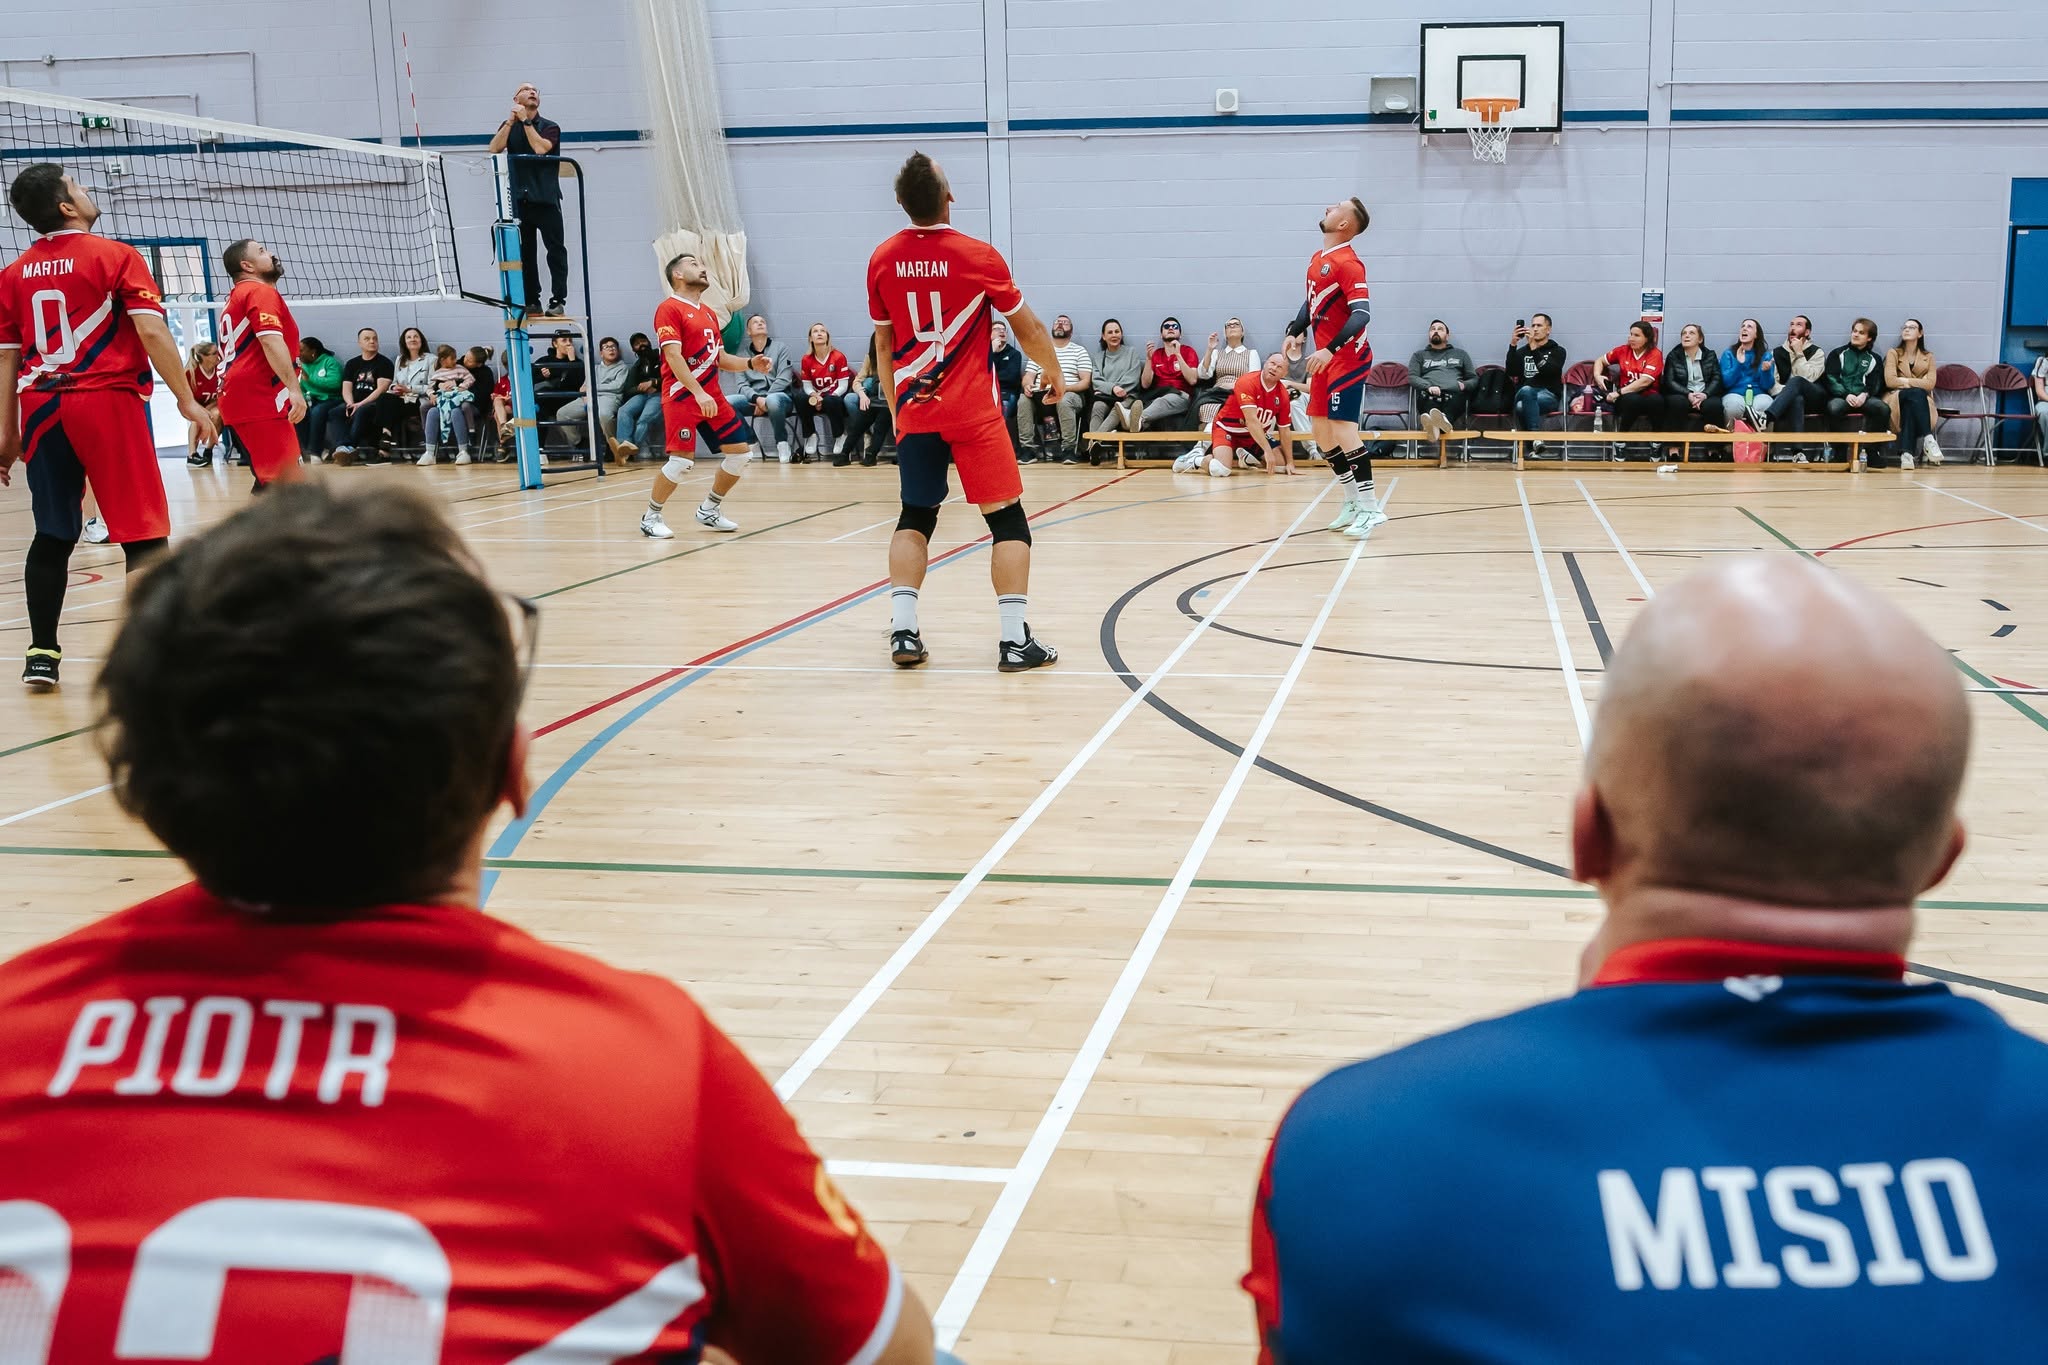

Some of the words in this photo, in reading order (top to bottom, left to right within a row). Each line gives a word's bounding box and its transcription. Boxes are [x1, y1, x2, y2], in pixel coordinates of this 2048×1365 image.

[22, 258, 75, 279] MARTIN
[895, 261, 949, 278] MARIAN
[31, 289, 76, 365] 0
[703, 328, 718, 354] 3
[906, 291, 945, 362] 4
[1330, 392, 1341, 405] 15
[47, 995, 396, 1108] PIOTR
[1597, 1157, 1997, 1291] MISIO
